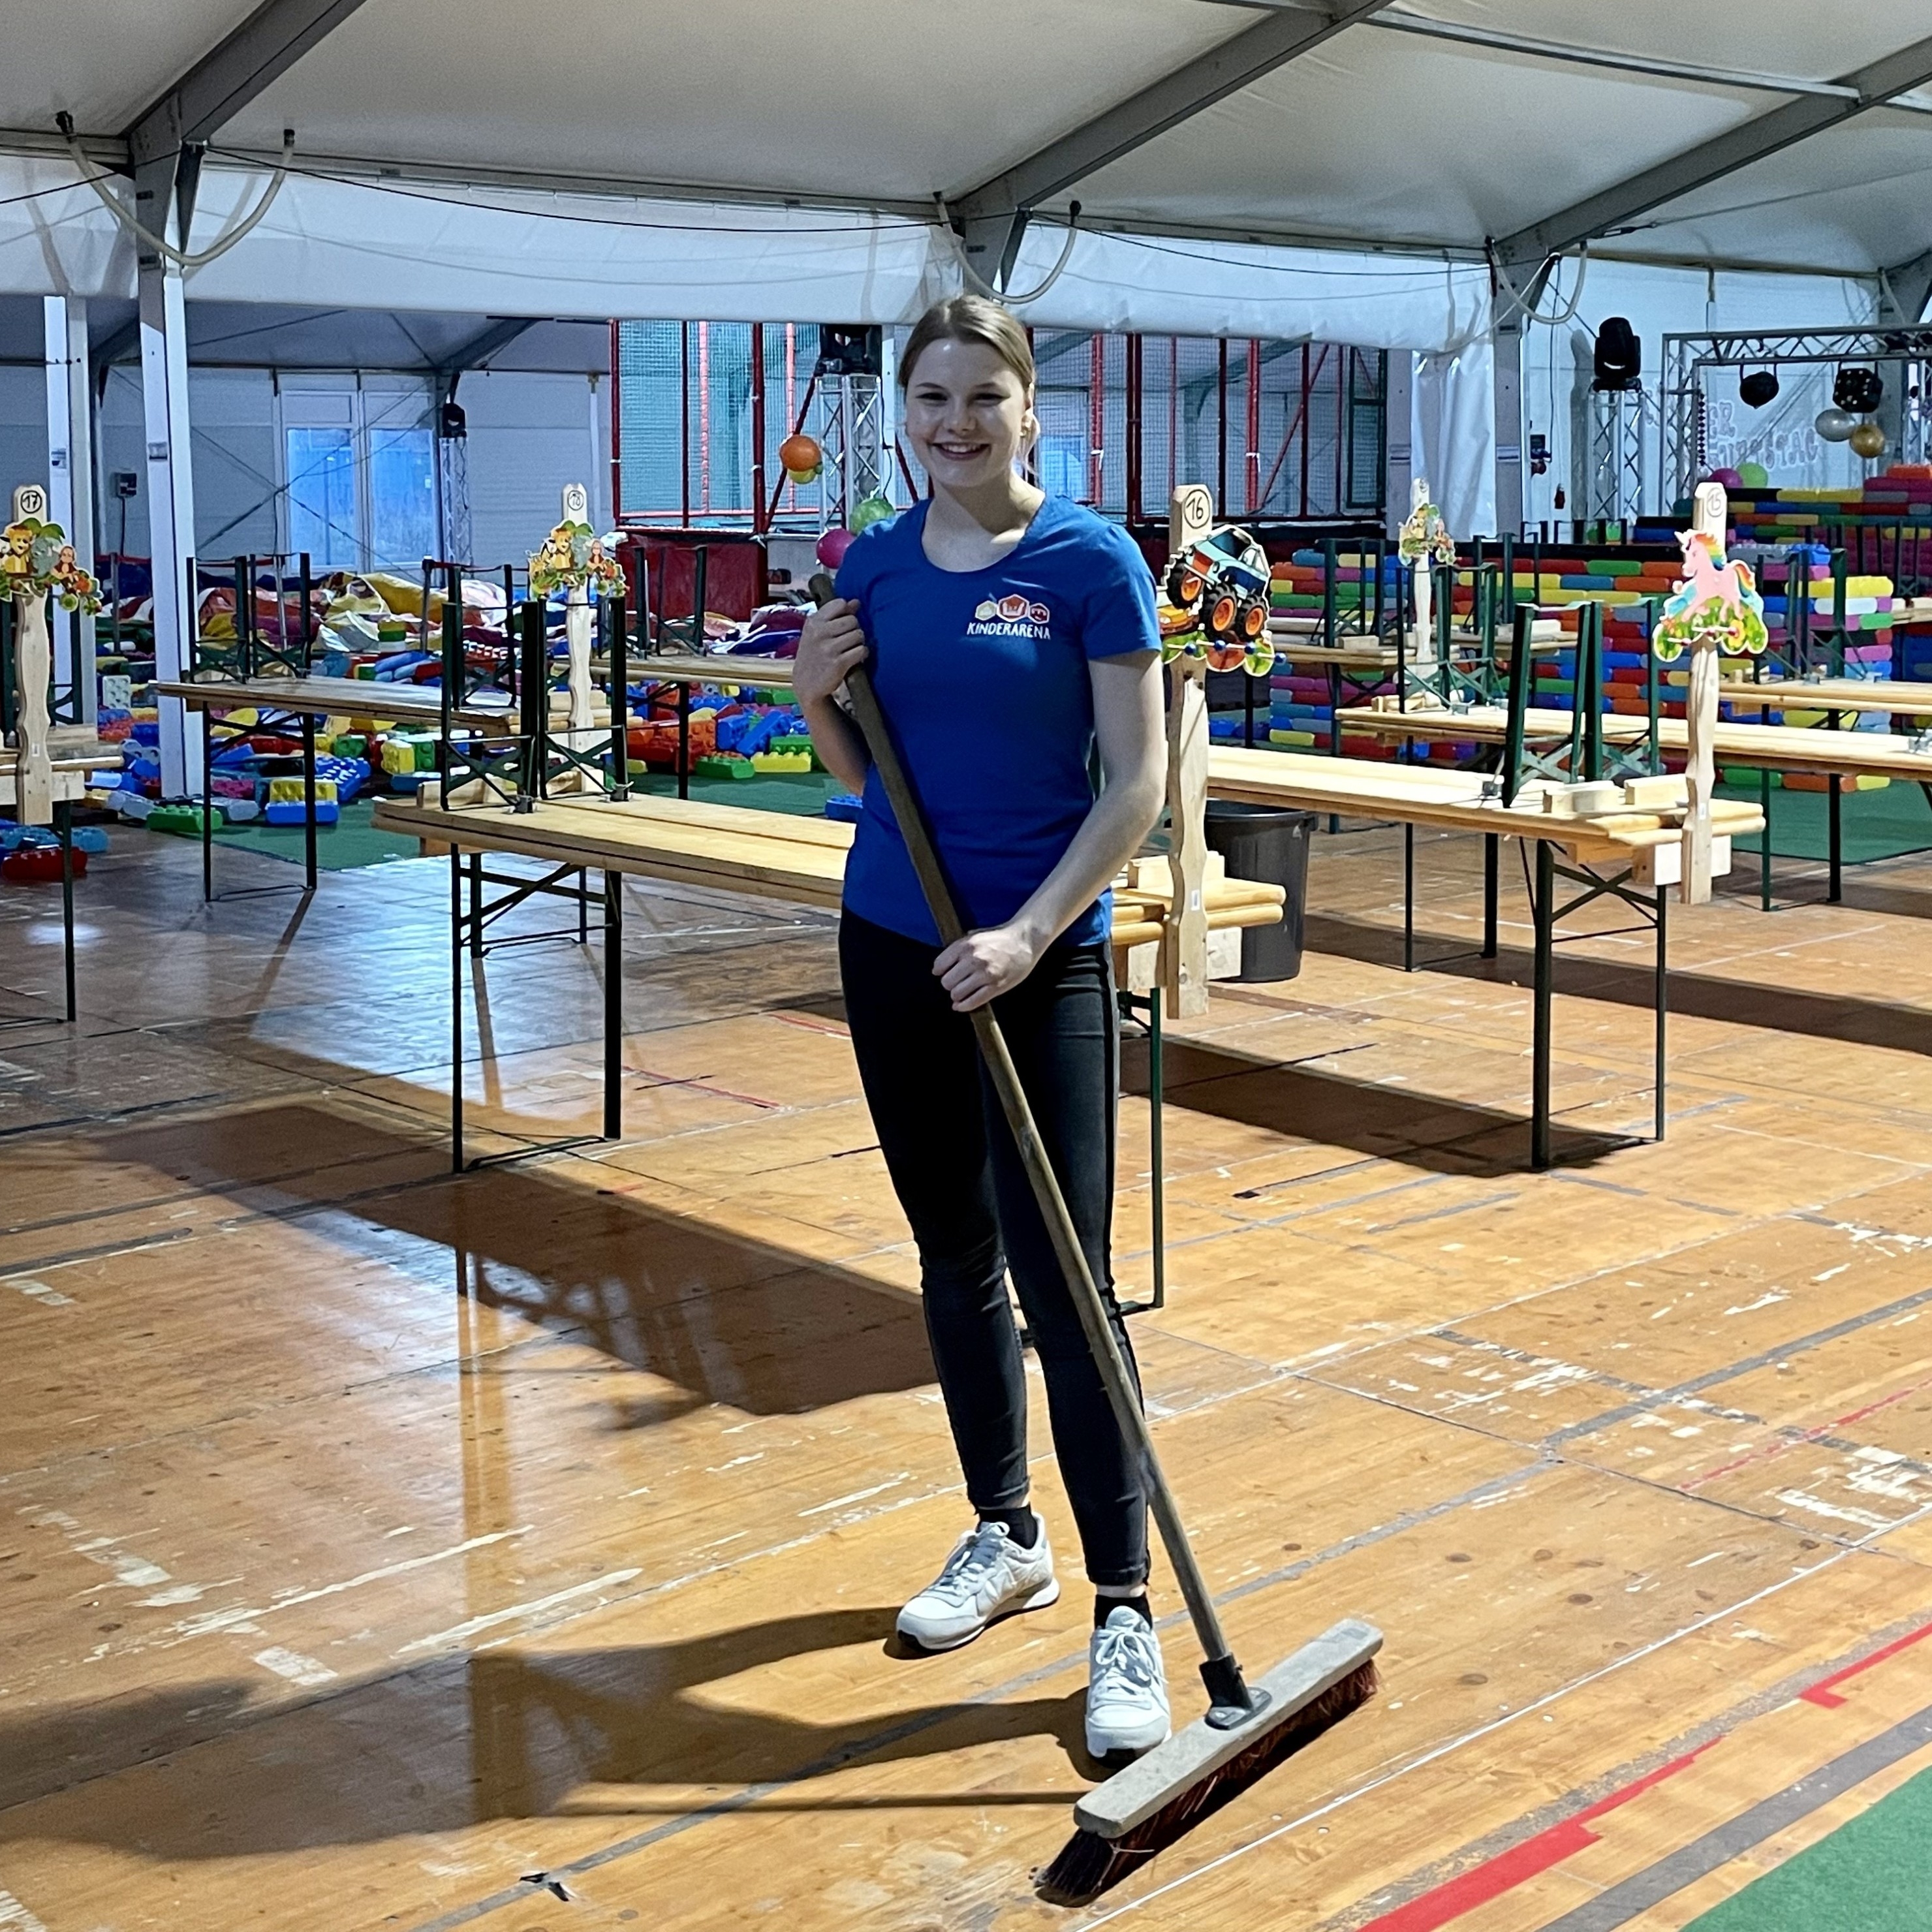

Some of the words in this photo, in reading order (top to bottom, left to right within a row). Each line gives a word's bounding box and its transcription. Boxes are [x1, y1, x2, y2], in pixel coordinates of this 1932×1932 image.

[22, 494, 38, 508] 17
[1186, 497, 1204, 520] 16
[1707, 491, 1722, 510] 15
[967, 622, 1051, 640] KINDERARENA
